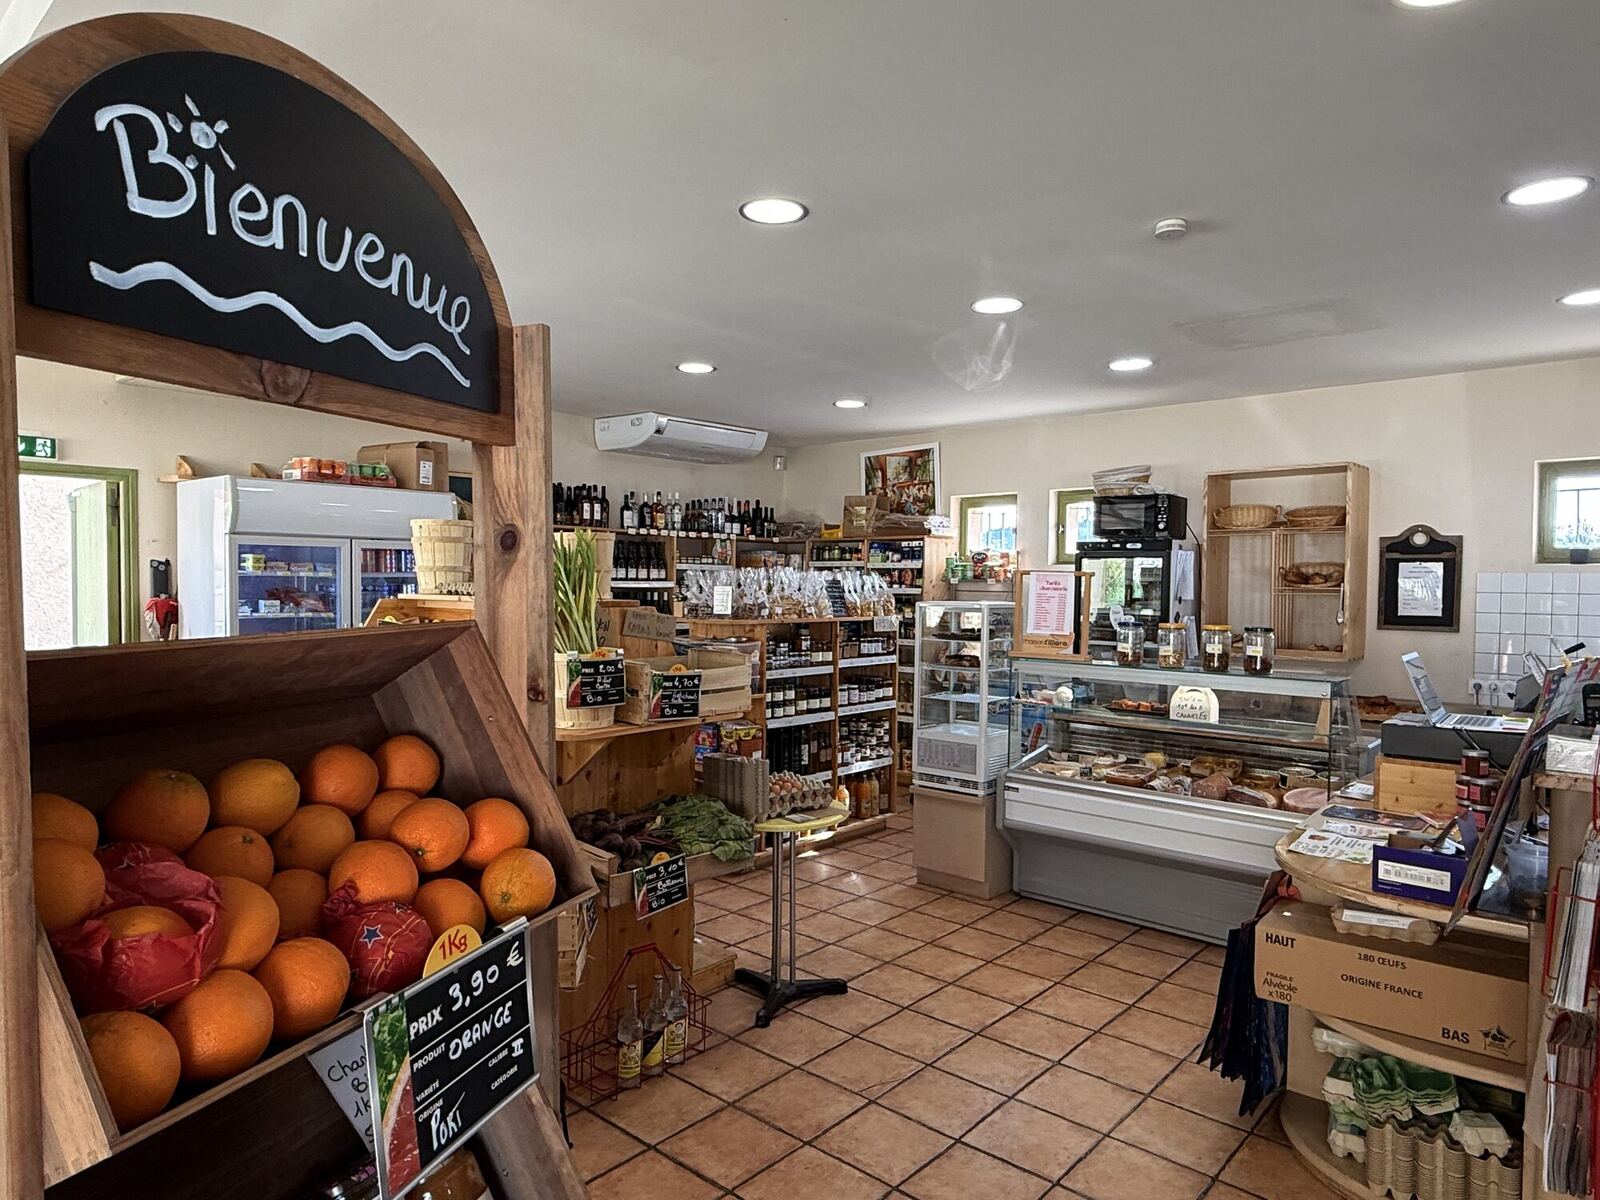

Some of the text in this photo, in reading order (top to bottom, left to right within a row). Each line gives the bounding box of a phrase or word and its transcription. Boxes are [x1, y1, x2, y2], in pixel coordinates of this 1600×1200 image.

[94, 93, 471, 355] Bienvenue
[438, 928, 468, 960] 1Kg
[1265, 932, 1297, 949] HAUT
[1357, 952, 1407, 970] 180 ŒUFS
[1262, 977, 1298, 994] Alvéole
[1266, 971, 1295, 983] FRAGILE
[1340, 973, 1424, 1000] ORIGINE FRANCE
[409, 940, 524, 1041] PRIX 3,90 €
[1268, 989, 1292, 1002] x180
[412, 1000, 513, 1073] PRODUIT ORANGE
[1441, 1026, 1470, 1044] BAS
[417, 1097, 445, 1123] ORIGINE
